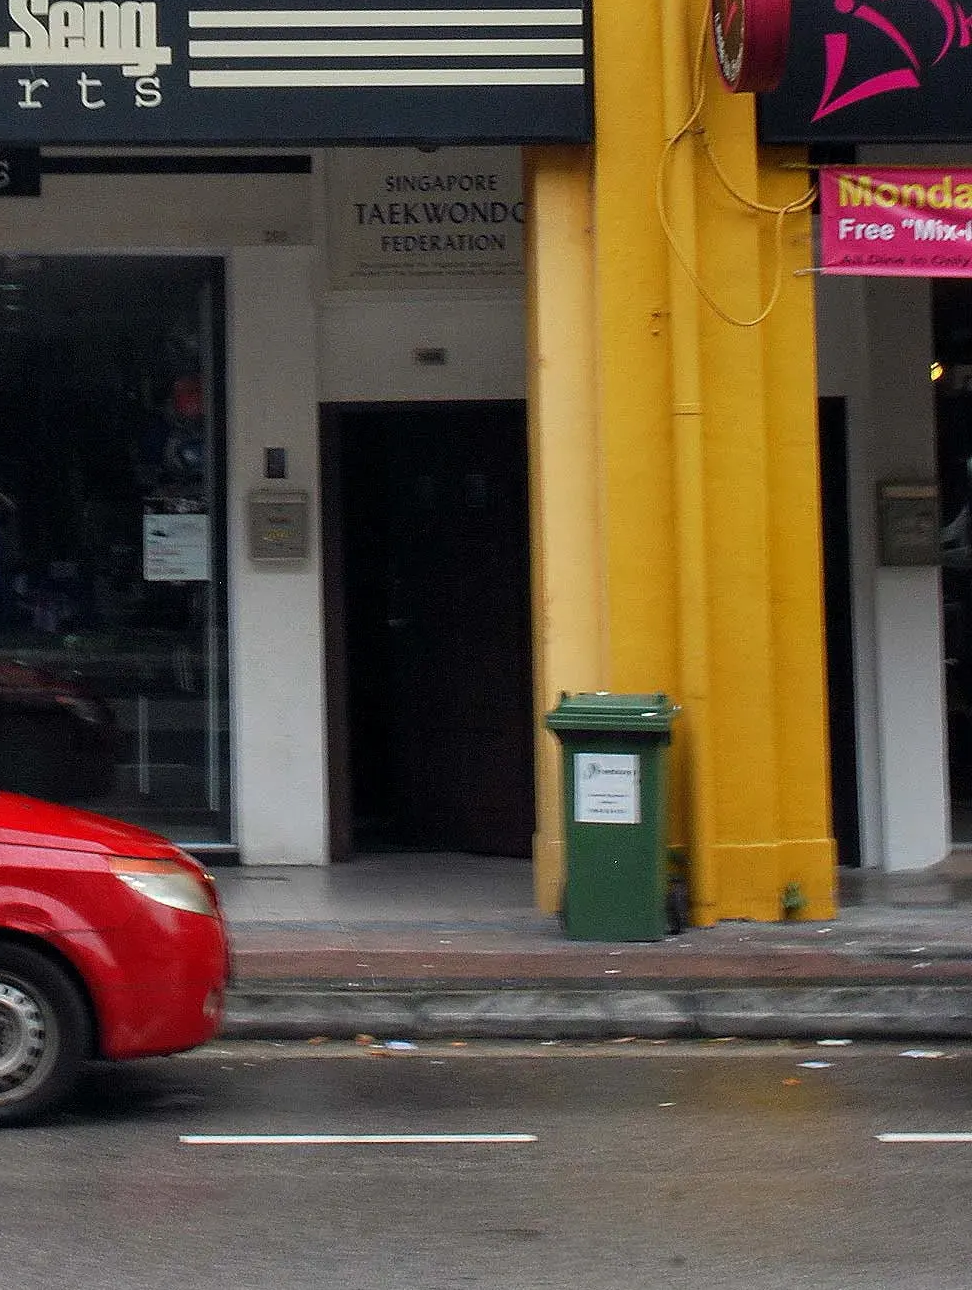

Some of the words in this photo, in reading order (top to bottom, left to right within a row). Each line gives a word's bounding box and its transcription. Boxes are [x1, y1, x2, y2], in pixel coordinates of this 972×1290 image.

[385, 174, 499, 192] SINGAPORE
[838, 173, 972, 210] Monda
[838, 218, 896, 241] Free
[380, 234, 506, 252] FEDERATION
